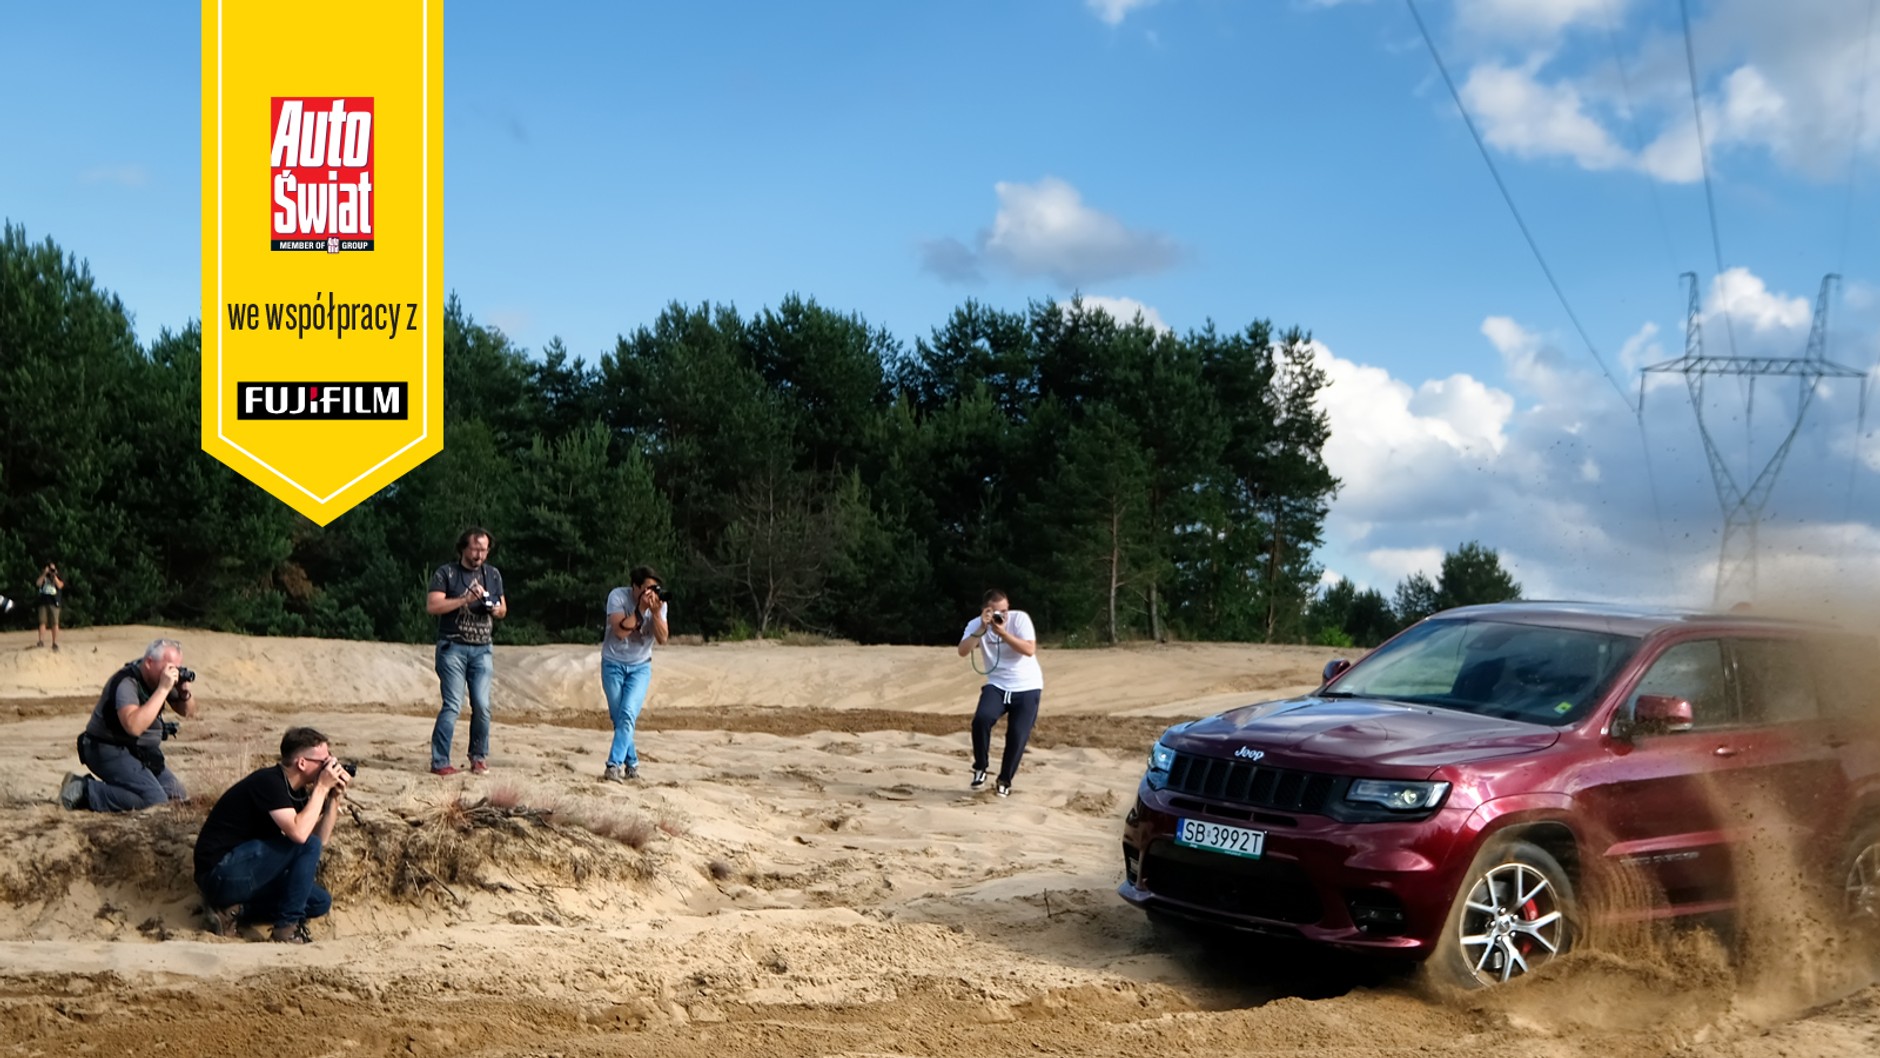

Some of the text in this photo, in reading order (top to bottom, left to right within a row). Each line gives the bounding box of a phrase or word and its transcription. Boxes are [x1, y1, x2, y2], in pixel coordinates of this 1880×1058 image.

[1234, 745, 1265, 761] Jeep
[1184, 821, 1262, 853] SB 3992T
